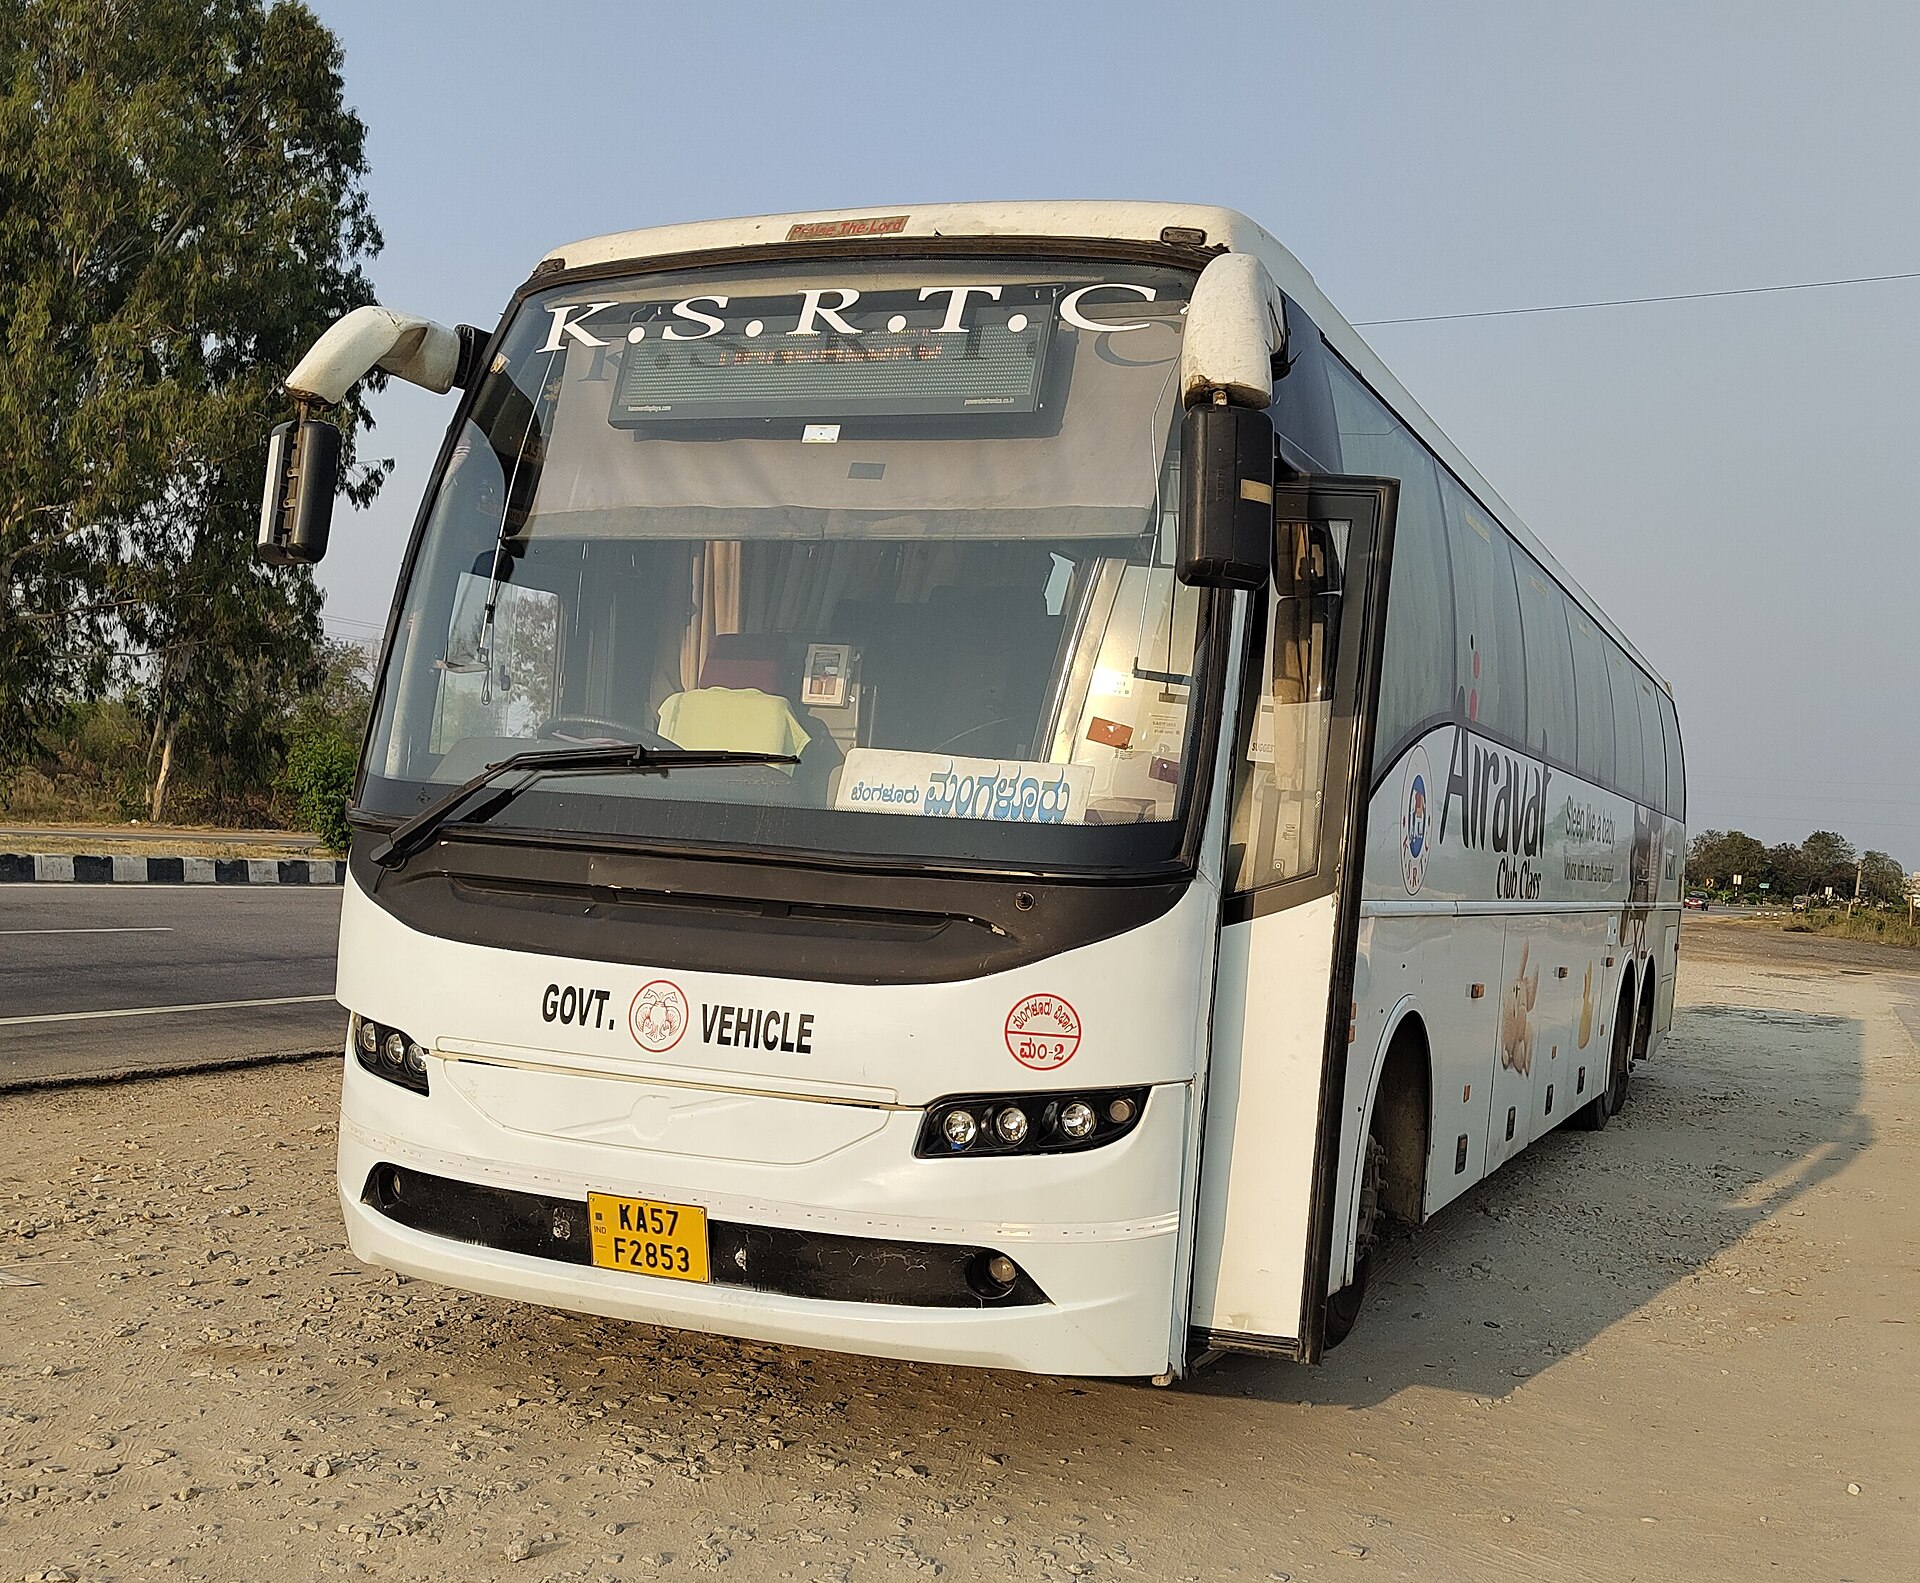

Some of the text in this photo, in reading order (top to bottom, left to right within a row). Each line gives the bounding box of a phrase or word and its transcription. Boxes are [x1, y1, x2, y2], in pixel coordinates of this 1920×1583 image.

[840, 222, 866, 234] The
[870, 218, 905, 233] Lord
[924, 759, 1071, 822] ಮಂಗಳೂರು
[1439, 686, 1553, 860] Airavat
[1496, 856, 1542, 899] Club Class
[541, 983, 815, 1054] GOVT. VEHICLE
[593, 1225, 607, 1235] IND
[618, 1203, 679, 1237] KA57
[613, 1236, 690, 1273] F2853
